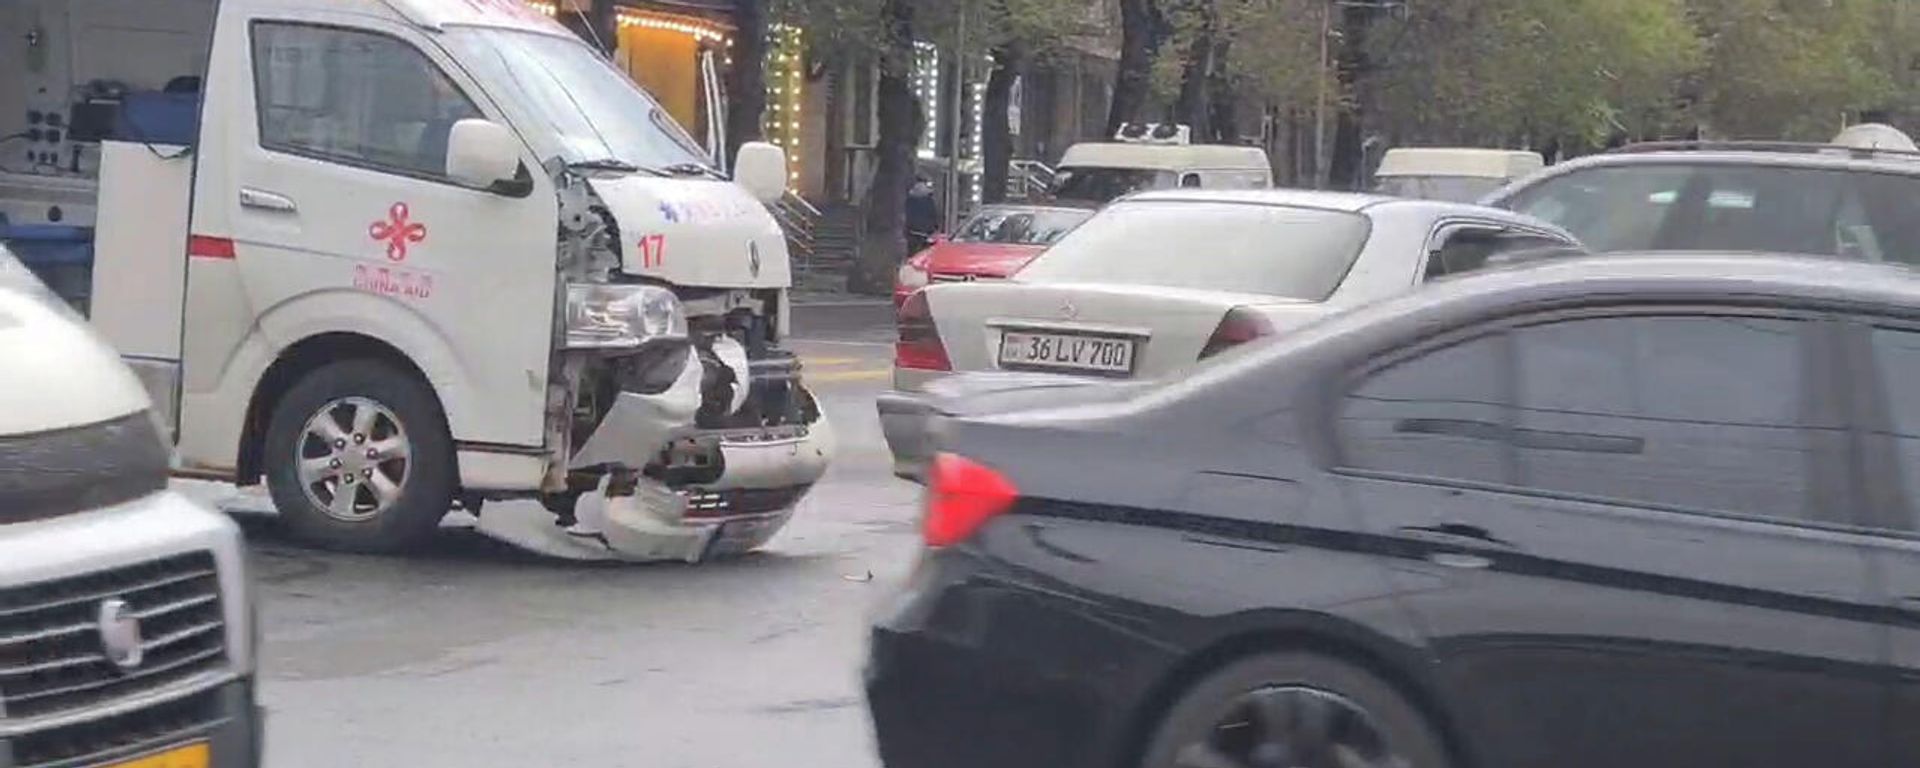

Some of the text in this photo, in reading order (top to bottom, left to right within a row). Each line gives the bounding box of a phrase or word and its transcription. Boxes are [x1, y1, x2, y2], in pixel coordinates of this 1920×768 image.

[638, 234, 665, 269] 17
[1028, 336, 1051, 361] 36
[1056, 338, 1086, 363] LV
[1090, 341, 1126, 367] 700
